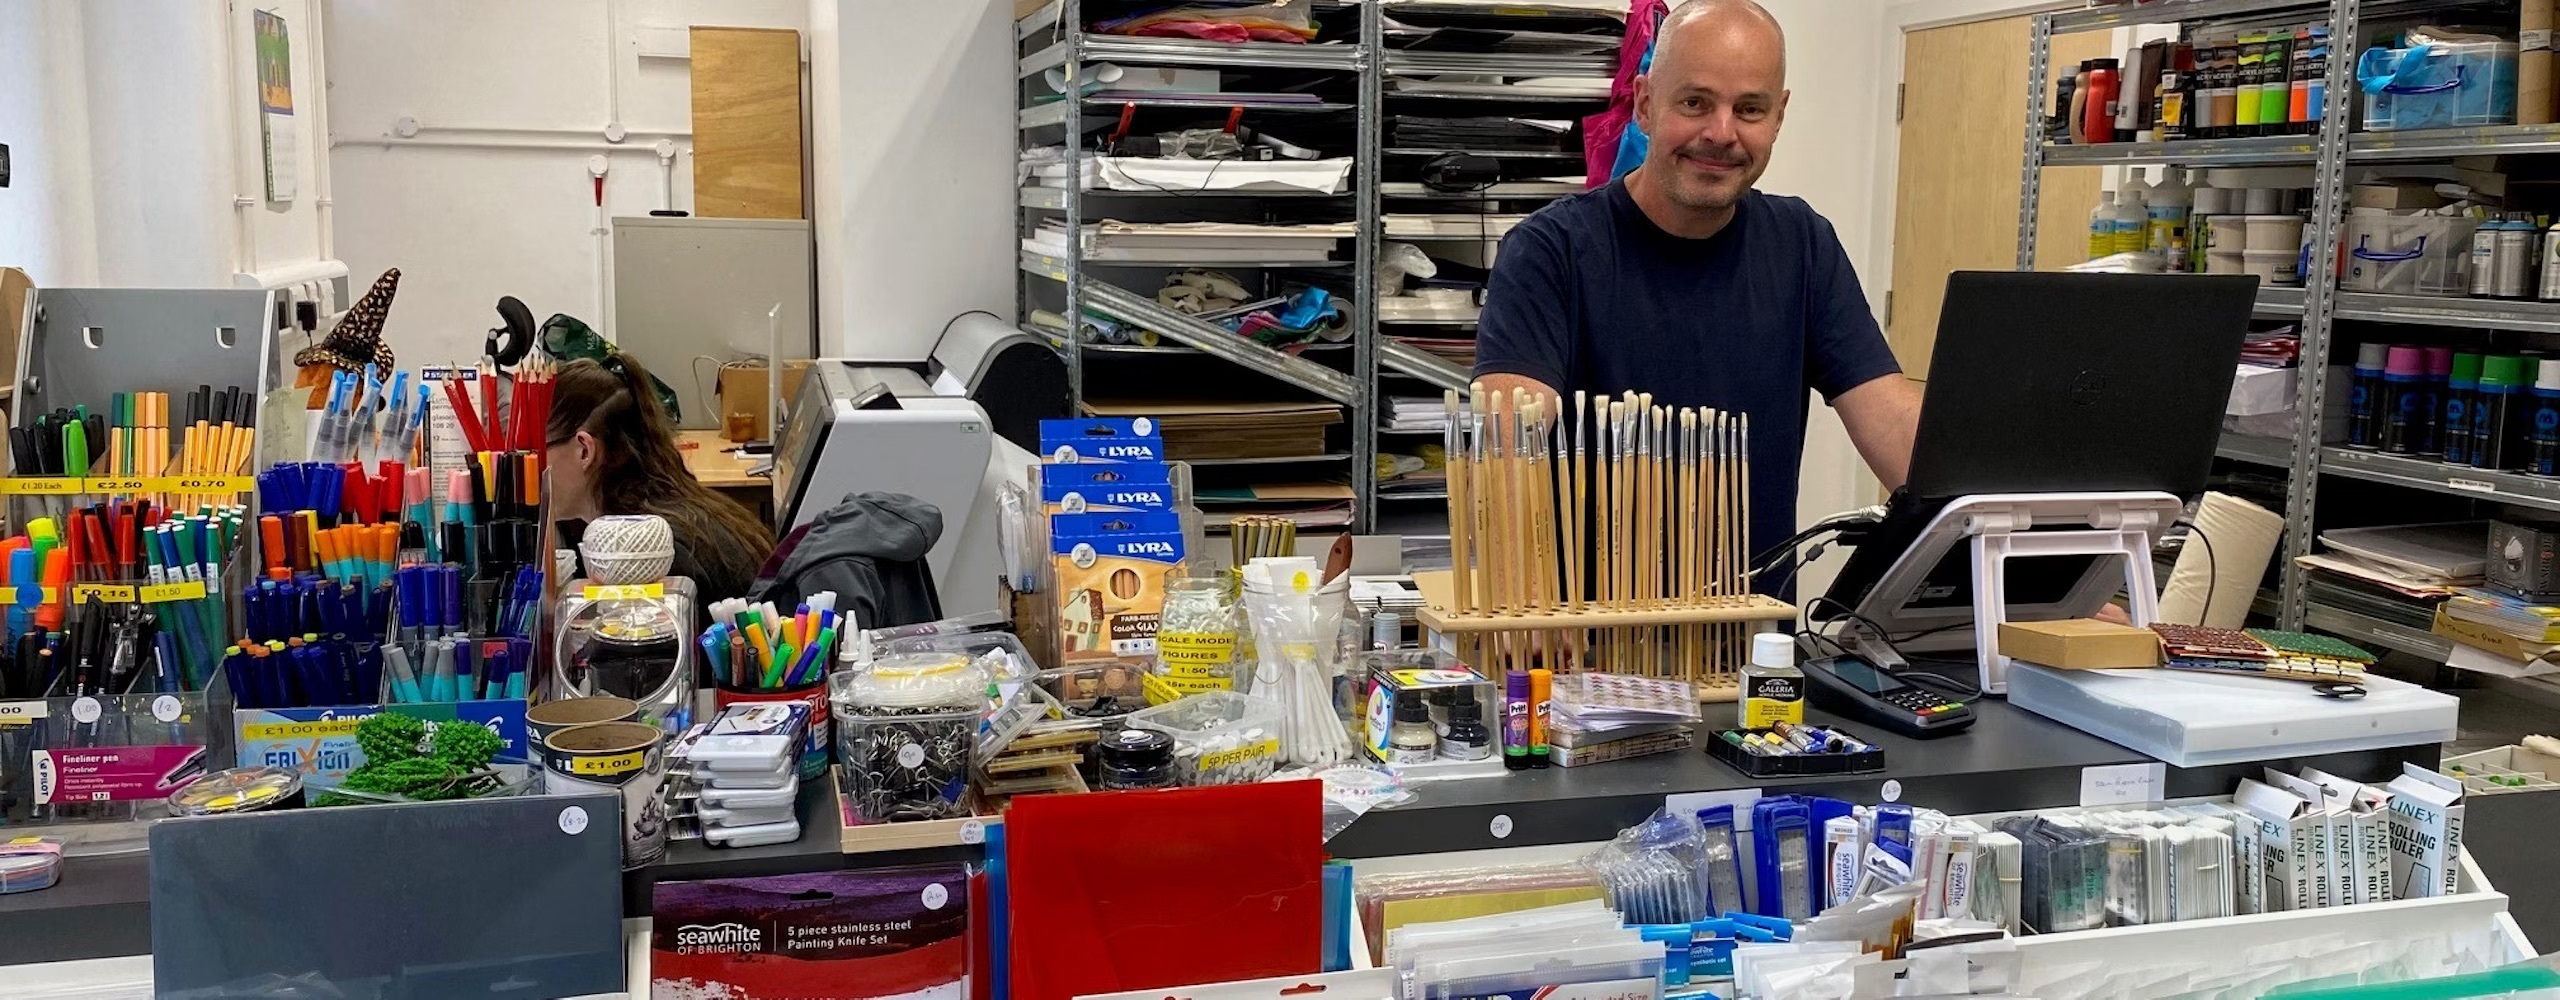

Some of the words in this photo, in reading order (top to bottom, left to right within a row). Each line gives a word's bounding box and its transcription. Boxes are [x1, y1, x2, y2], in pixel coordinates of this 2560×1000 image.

[1109, 446, 1153, 457] LYRA
[43, 482, 62, 490] Each
[97, 481, 142, 489] £2.50
[180, 480, 225, 488] £0.70
[1117, 492, 1162, 503] LYRA
[1128, 542, 1174, 553] LYRA
[156, 588, 181, 597] £1.50
[1162, 651, 1218, 660] FIGURES
[1758, 685, 1794, 693] GALERIA
[265, 725, 312, 736] £1.00
[318, 723, 359, 734] each
[62, 754, 101, 764] Fineliner
[102, 754, 119, 764] pen
[585, 759, 632, 769] £1.00
[1208, 757, 1220, 768] 5P
[1222, 753, 1242, 765] PER
[1243, 745, 1266, 761] PAIR
[62, 766, 98, 774] Fineliner
[41, 771, 50, 797] PILOT
[2389, 798, 2435, 825] LINEX
[2377, 820, 2388, 864] LINEX
[2388, 821, 2436, 850] ROLLING
[2448, 817, 2460, 863] LINEX
[2297, 828, 2306, 872] LINEX
[2315, 825, 2326, 869] LINEX
[2339, 824, 2350, 869] LINEX
[2365, 825, 2376, 870] LINEX
[1842, 852, 1852, 898] seawhite
[1954, 861, 1965, 906] seawhite
[677, 924, 761, 945] seawhite
[788, 926, 795, 936] 5
[797, 924, 828, 938] piece
[831, 921, 881, 934] stainless
[884, 919, 912, 932] steel
[677, 944, 693, 956] OF
[698, 942, 761, 955] BRIGHTON
[788, 937, 834, 950] Painting
[837, 936, 867, 947] Knife
[870, 934, 888, 946] Set
